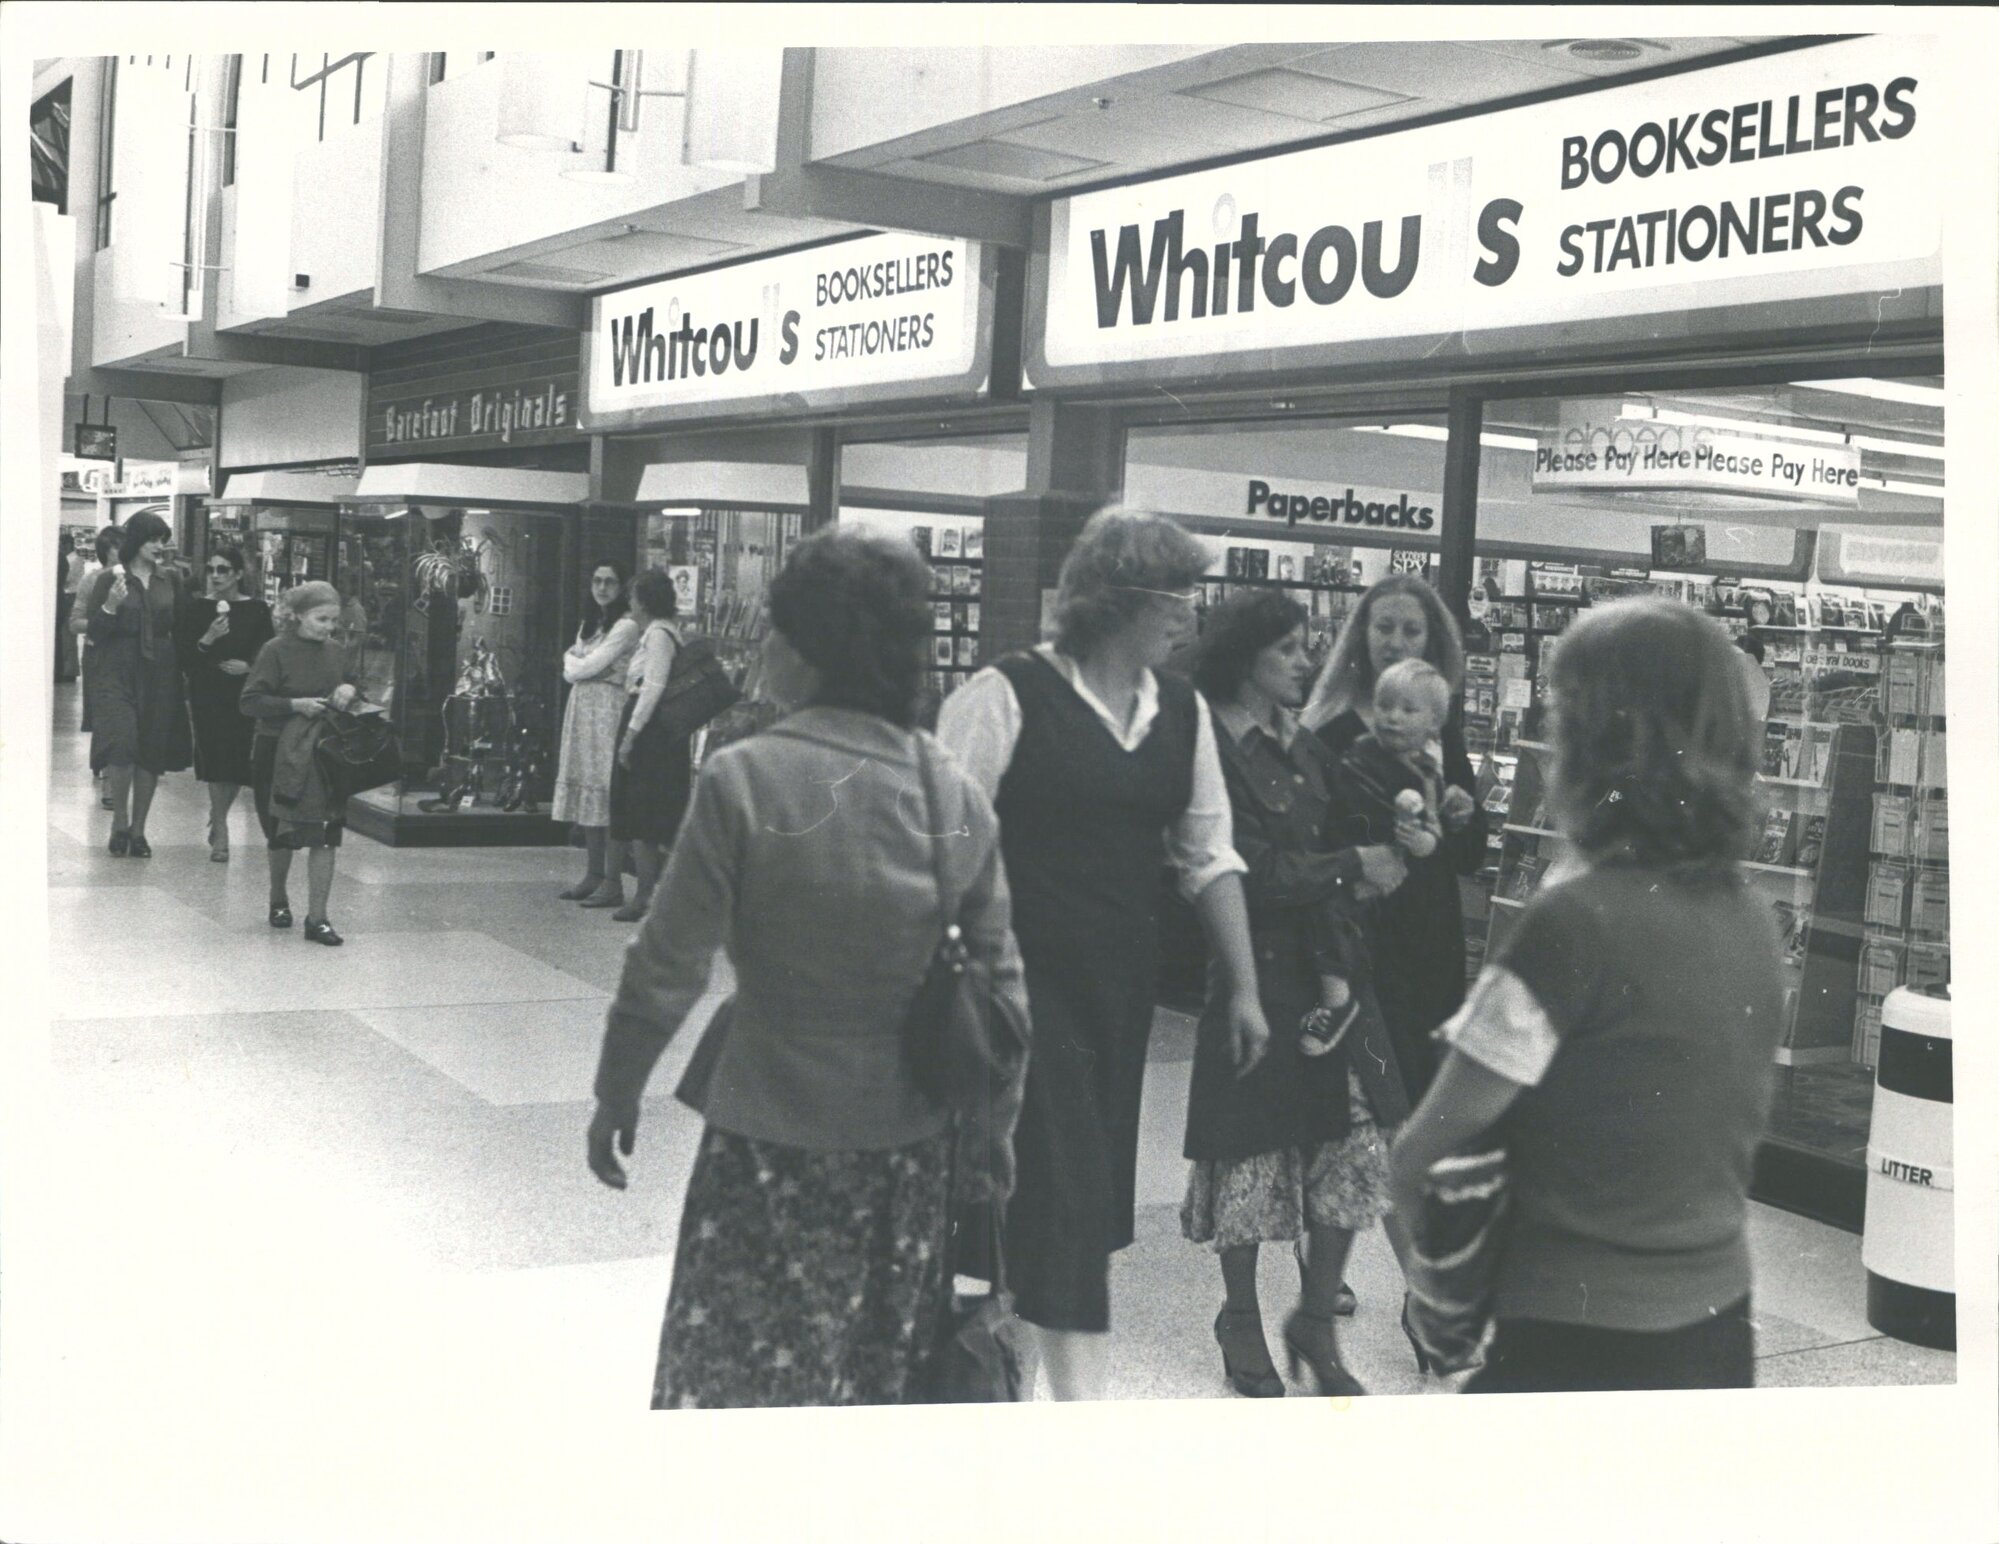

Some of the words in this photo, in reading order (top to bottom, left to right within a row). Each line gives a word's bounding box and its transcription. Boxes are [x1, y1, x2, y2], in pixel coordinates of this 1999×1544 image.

[1560, 77, 1917, 190] BOOKSELLERS
[1556, 186, 1863, 278] STATIONERS
[816, 250, 953, 307] BOOKSELLERS
[814, 313, 934, 361] STATIONERS
[470, 384, 567, 443] Originals
[1535, 447, 1596, 473] Please
[1604, 447, 1638, 475] Pay
[1644, 445, 1691, 469] Here
[1695, 445, 1762, 476] Please
[1771, 453, 1805, 486] Pay
[1812, 460, 1858, 487] Here
[1247, 480, 1434, 529] Paperbacks
[1393, 559, 1427, 574] SPY
[1881, 1157, 1932, 1186] LITTER
